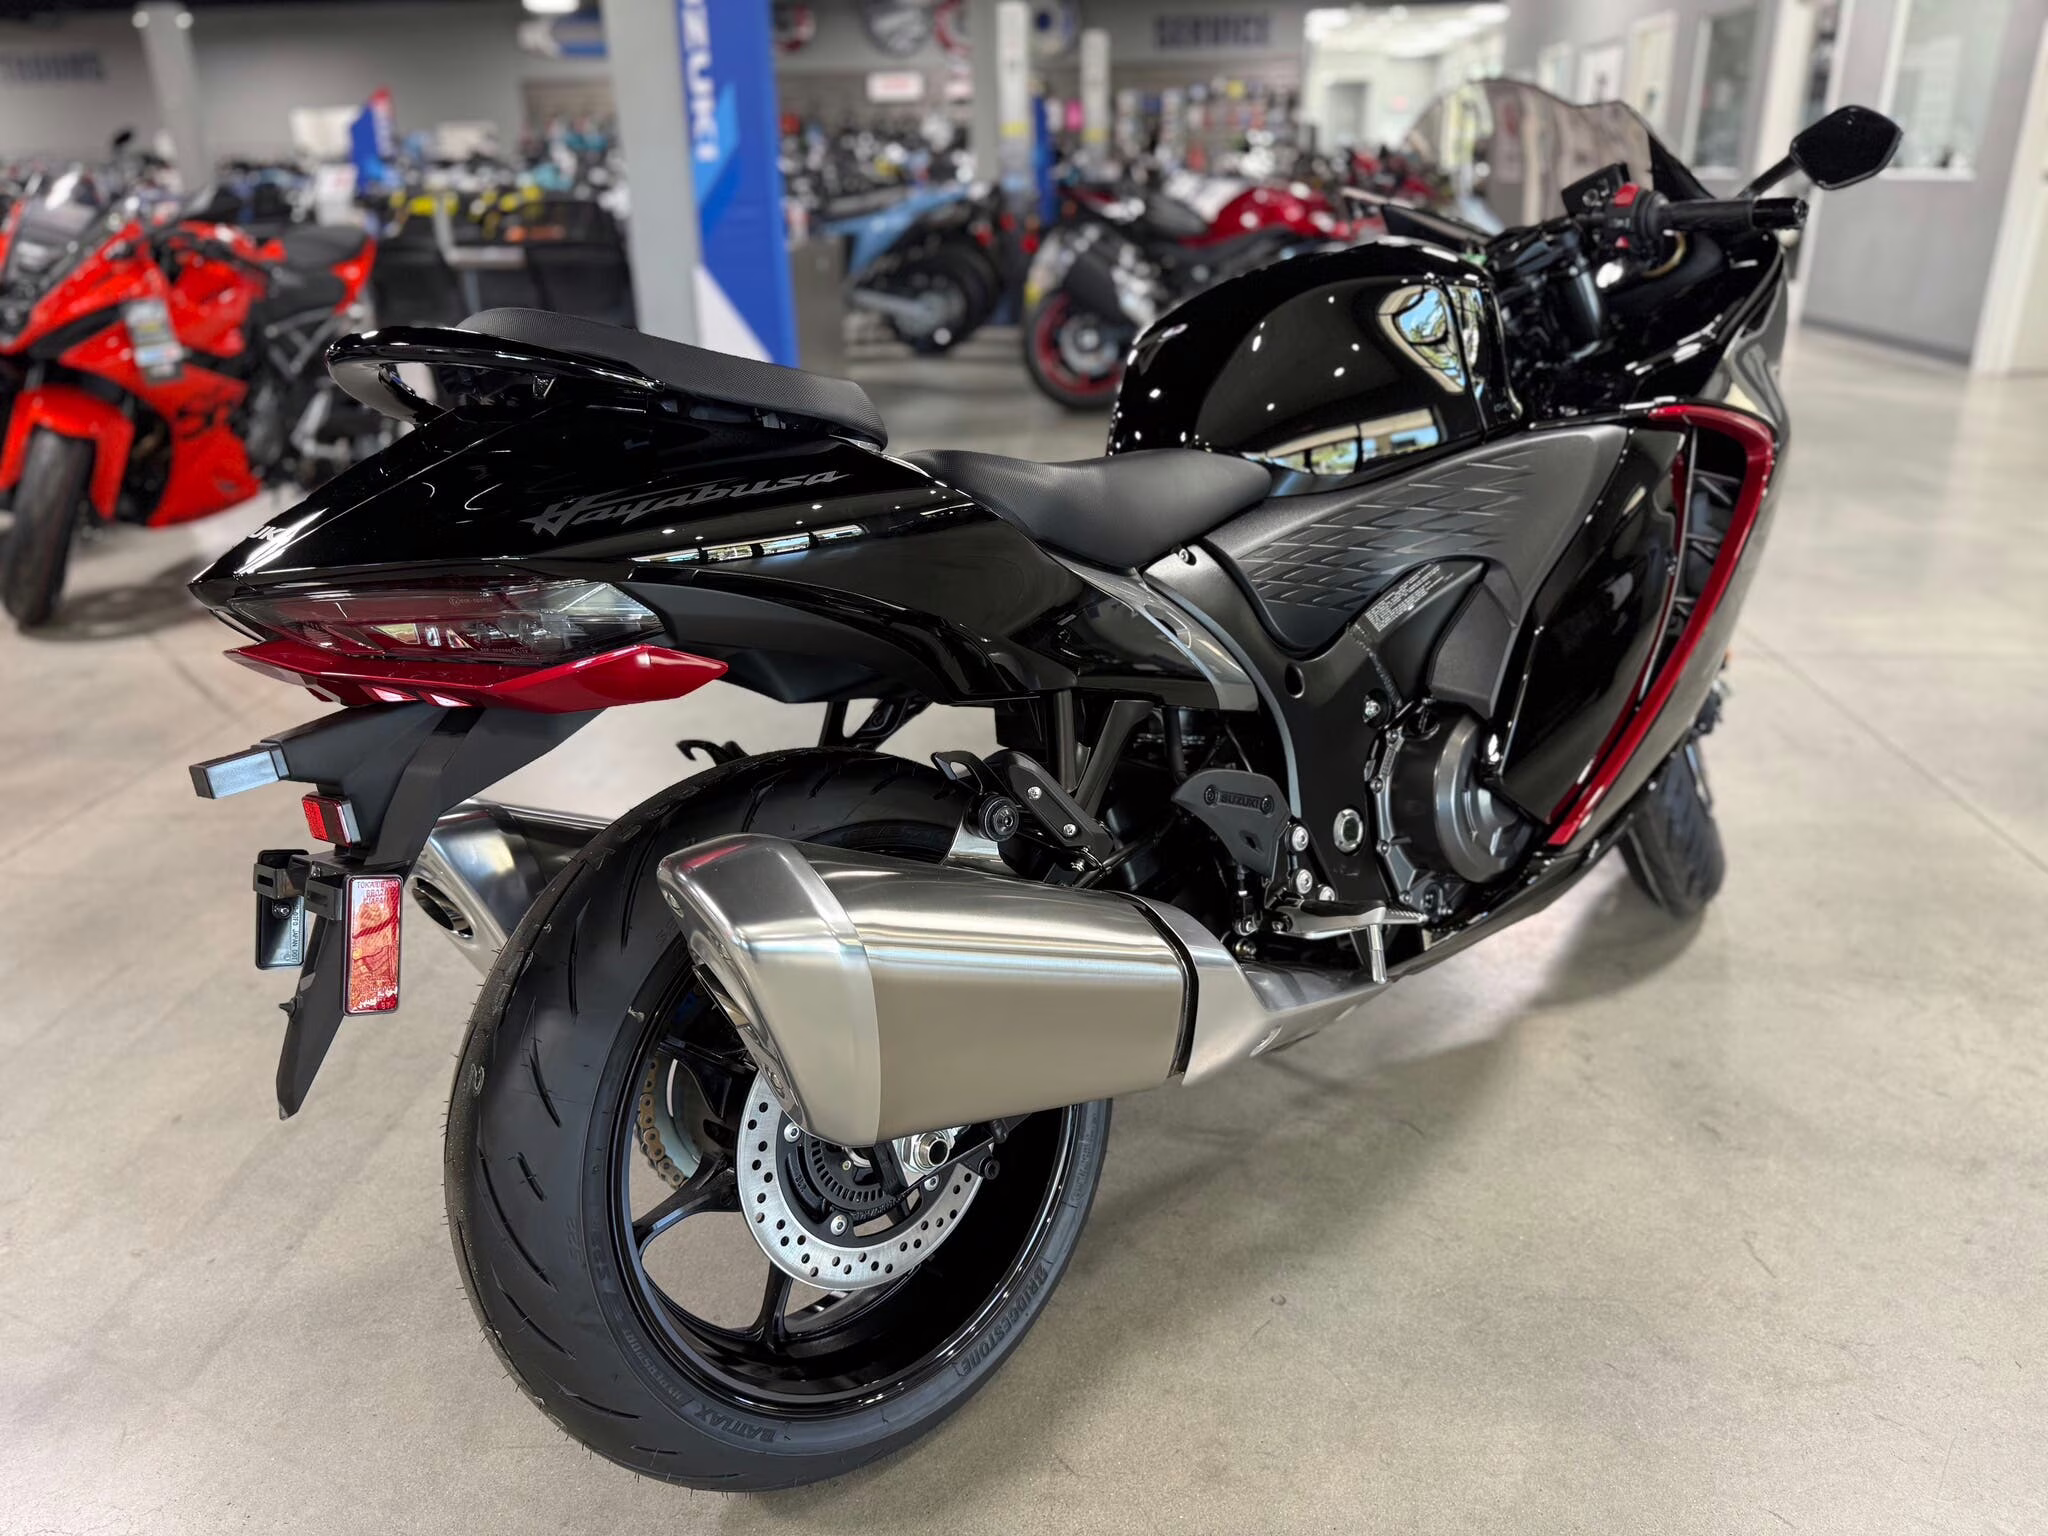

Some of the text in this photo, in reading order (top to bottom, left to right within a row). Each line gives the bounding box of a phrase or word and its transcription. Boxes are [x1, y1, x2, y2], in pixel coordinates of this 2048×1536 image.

[683, 0, 720, 163] ZUKI
[521, 470, 851, 536] Hayabusa
[1220, 793, 1259, 808] SUZUKI
[961, 1262, 1049, 1376] BRIDGESTONE
